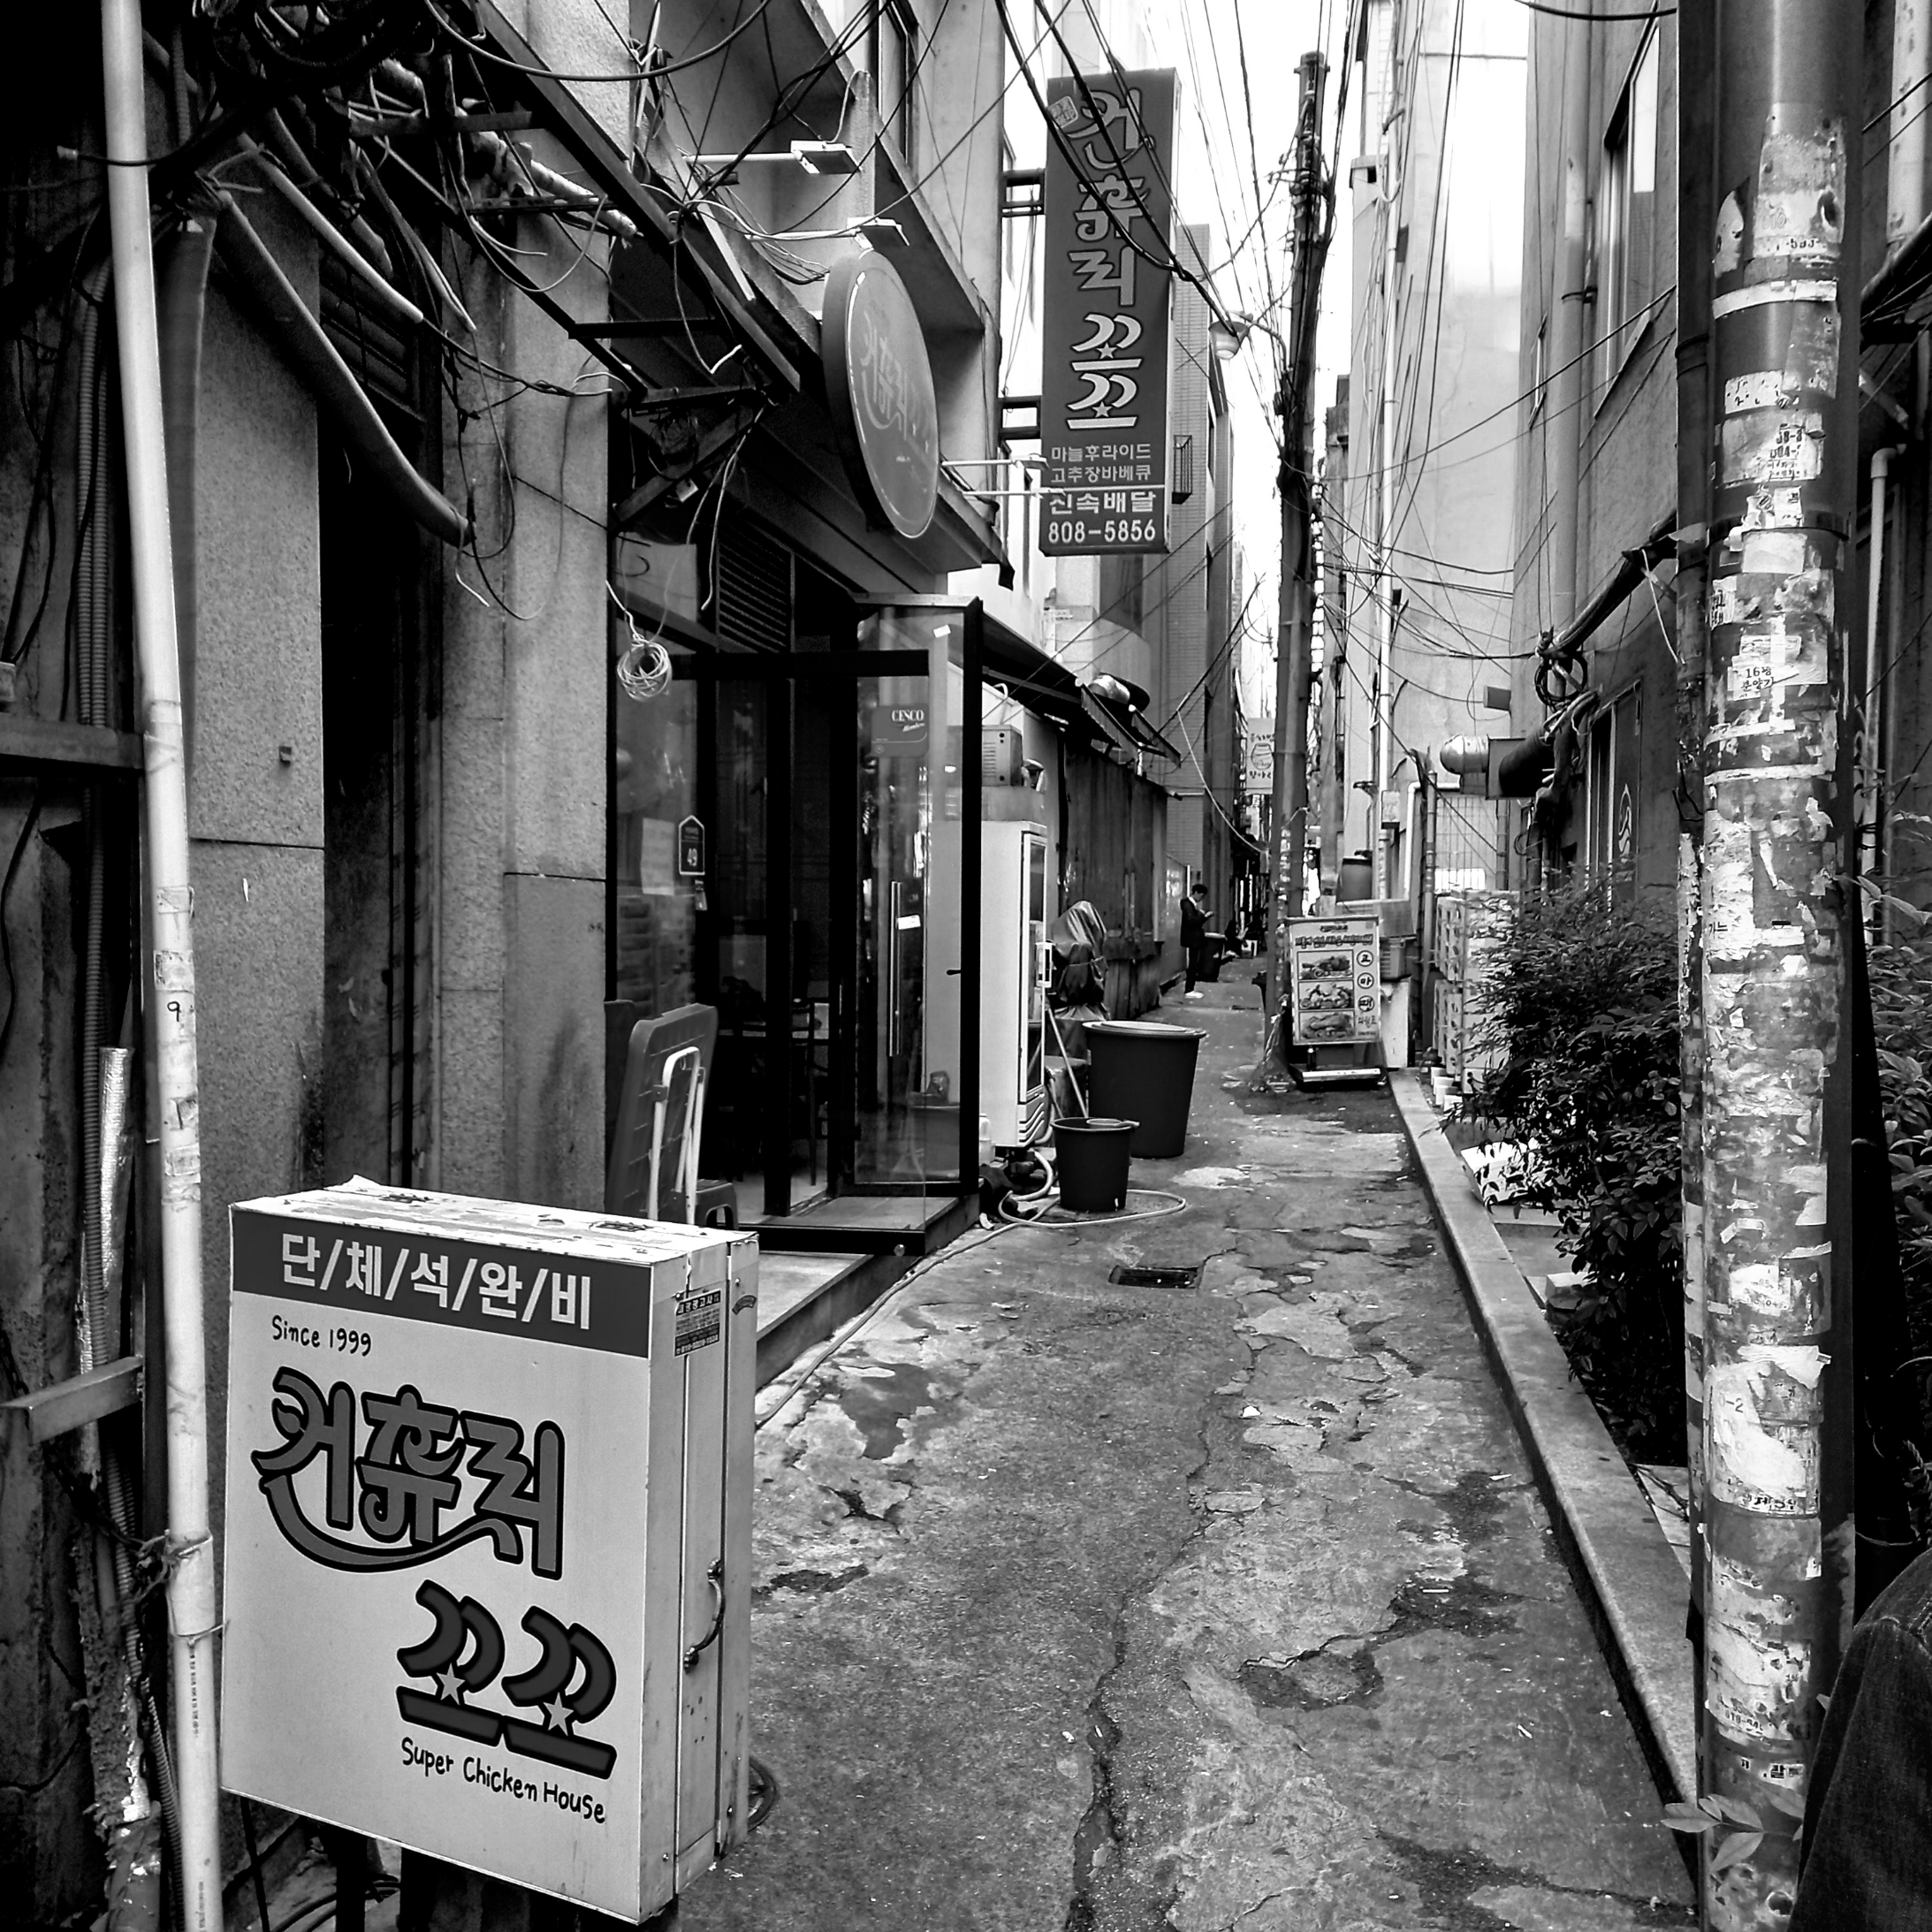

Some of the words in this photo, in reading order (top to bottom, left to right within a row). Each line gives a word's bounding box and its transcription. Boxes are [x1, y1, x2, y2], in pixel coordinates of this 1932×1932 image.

[1066, 313, 1143, 430] 꼬꼬
[1051, 444, 1151, 463] 마늘후라이드
[1051, 465, 1151, 483] 고추장바베큐
[1049, 491, 1156, 515] 신속배달
[1048, 519, 1156, 544] 808-5856
[891, 709, 924, 722] CESCO
[282, 1233, 590, 1330] 단/체/석/완/비
[271, 1314, 321, 1349] Since
[329, 1328, 372, 1357] 1999
[396, 1578, 618, 1780] 꼬꼬
[401, 1737, 454, 1777] Super
[462, 1756, 537, 1802] Chicken
